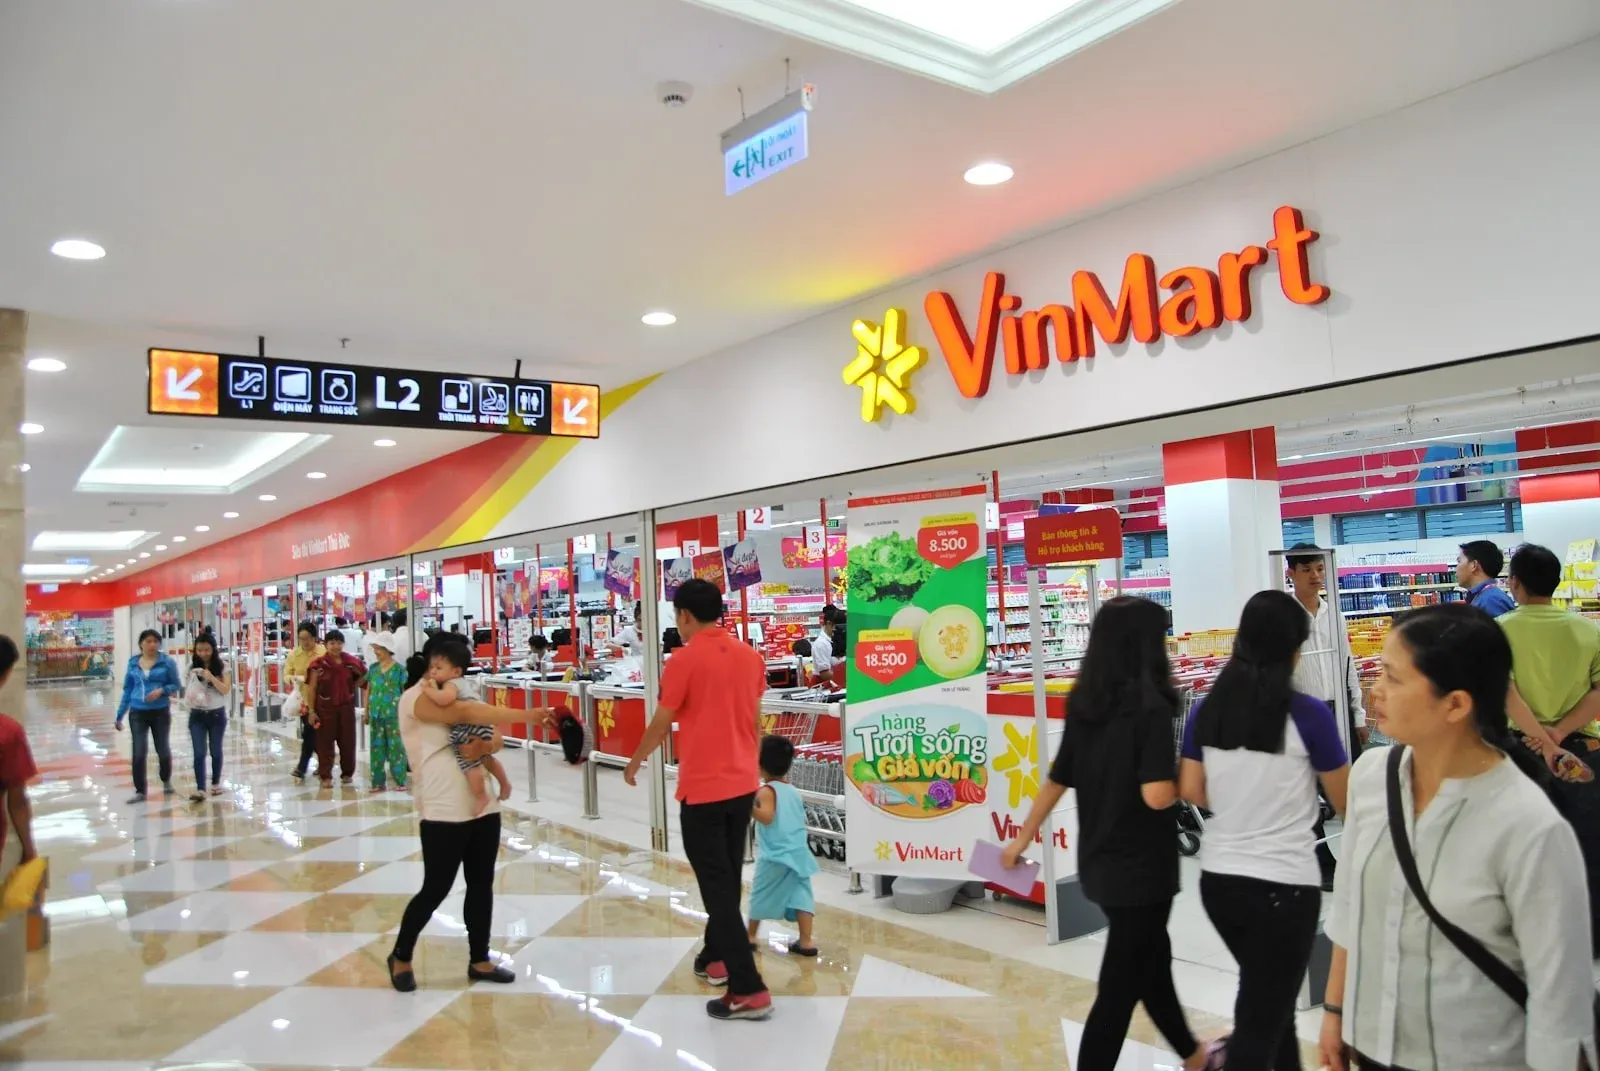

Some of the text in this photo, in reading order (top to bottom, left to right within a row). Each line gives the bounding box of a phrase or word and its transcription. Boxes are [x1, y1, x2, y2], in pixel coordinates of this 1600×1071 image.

[768, 146, 794, 168] EXIT
[924, 205, 1330, 398] VinMart
[376, 375, 420, 412] L2
[241, 399, 254, 409] L1
[319, 404, 343, 414] TRANG
[455, 413, 477, 423] TRANG
[523, 417, 537, 427] WC
[753, 506, 764, 524] 2
[987, 508, 992, 523] 1
[811, 531, 820, 544] 3
[1079, 527, 1090, 537] tin
[1091, 525, 1099, 535] &
[688, 545, 696, 556] 5
[929, 537, 968, 552] 8.500
[598, 557, 606, 567] 7
[864, 653, 907, 667] 18.500
[881, 713, 926, 734] hàng
[853, 725, 915, 763] Tươi
[877, 752, 970, 781] Giá vốn
[991, 811, 1068, 849] Vinrt
[895, 841, 964, 862] VinMart
